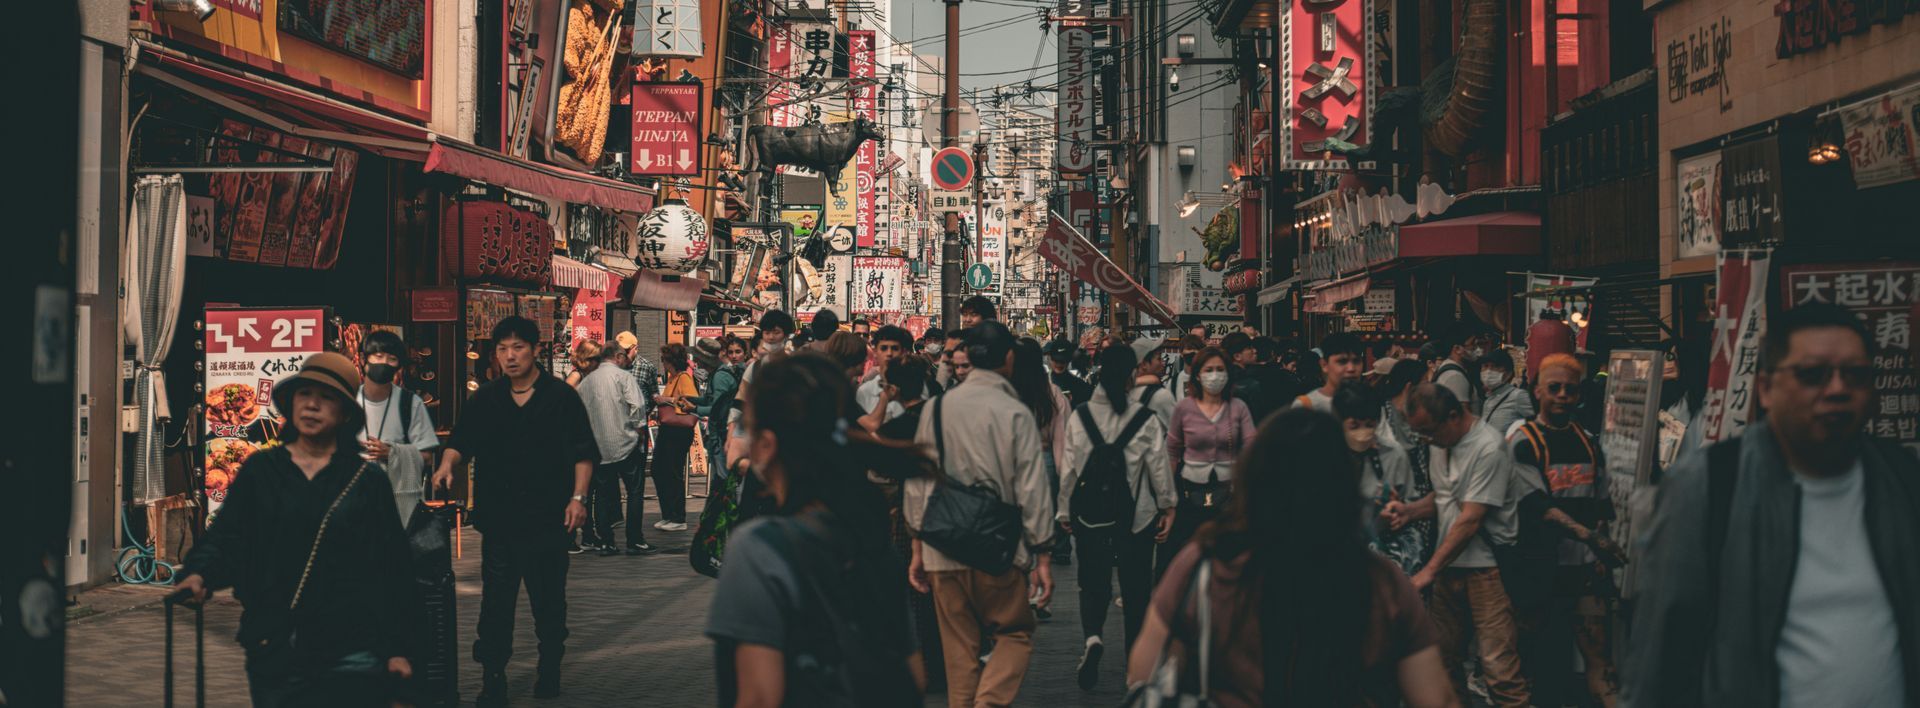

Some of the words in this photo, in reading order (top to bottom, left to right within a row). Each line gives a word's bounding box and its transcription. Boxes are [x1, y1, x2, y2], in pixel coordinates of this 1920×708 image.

[1066, 31, 1084, 128] ドラゴンボウル
[1300, 0, 1361, 152] ーメン
[651, 87, 697, 96] TEPPANYAKI
[635, 110, 696, 124] TEPPAN
[634, 130, 689, 143] JINJYA
[656, 154, 673, 167] B1
[934, 196, 969, 208] 自動車
[867, 269, 884, 309] 射的
[1200, 298, 1238, 312] 大たこ
[271, 318, 316, 348] 2F
